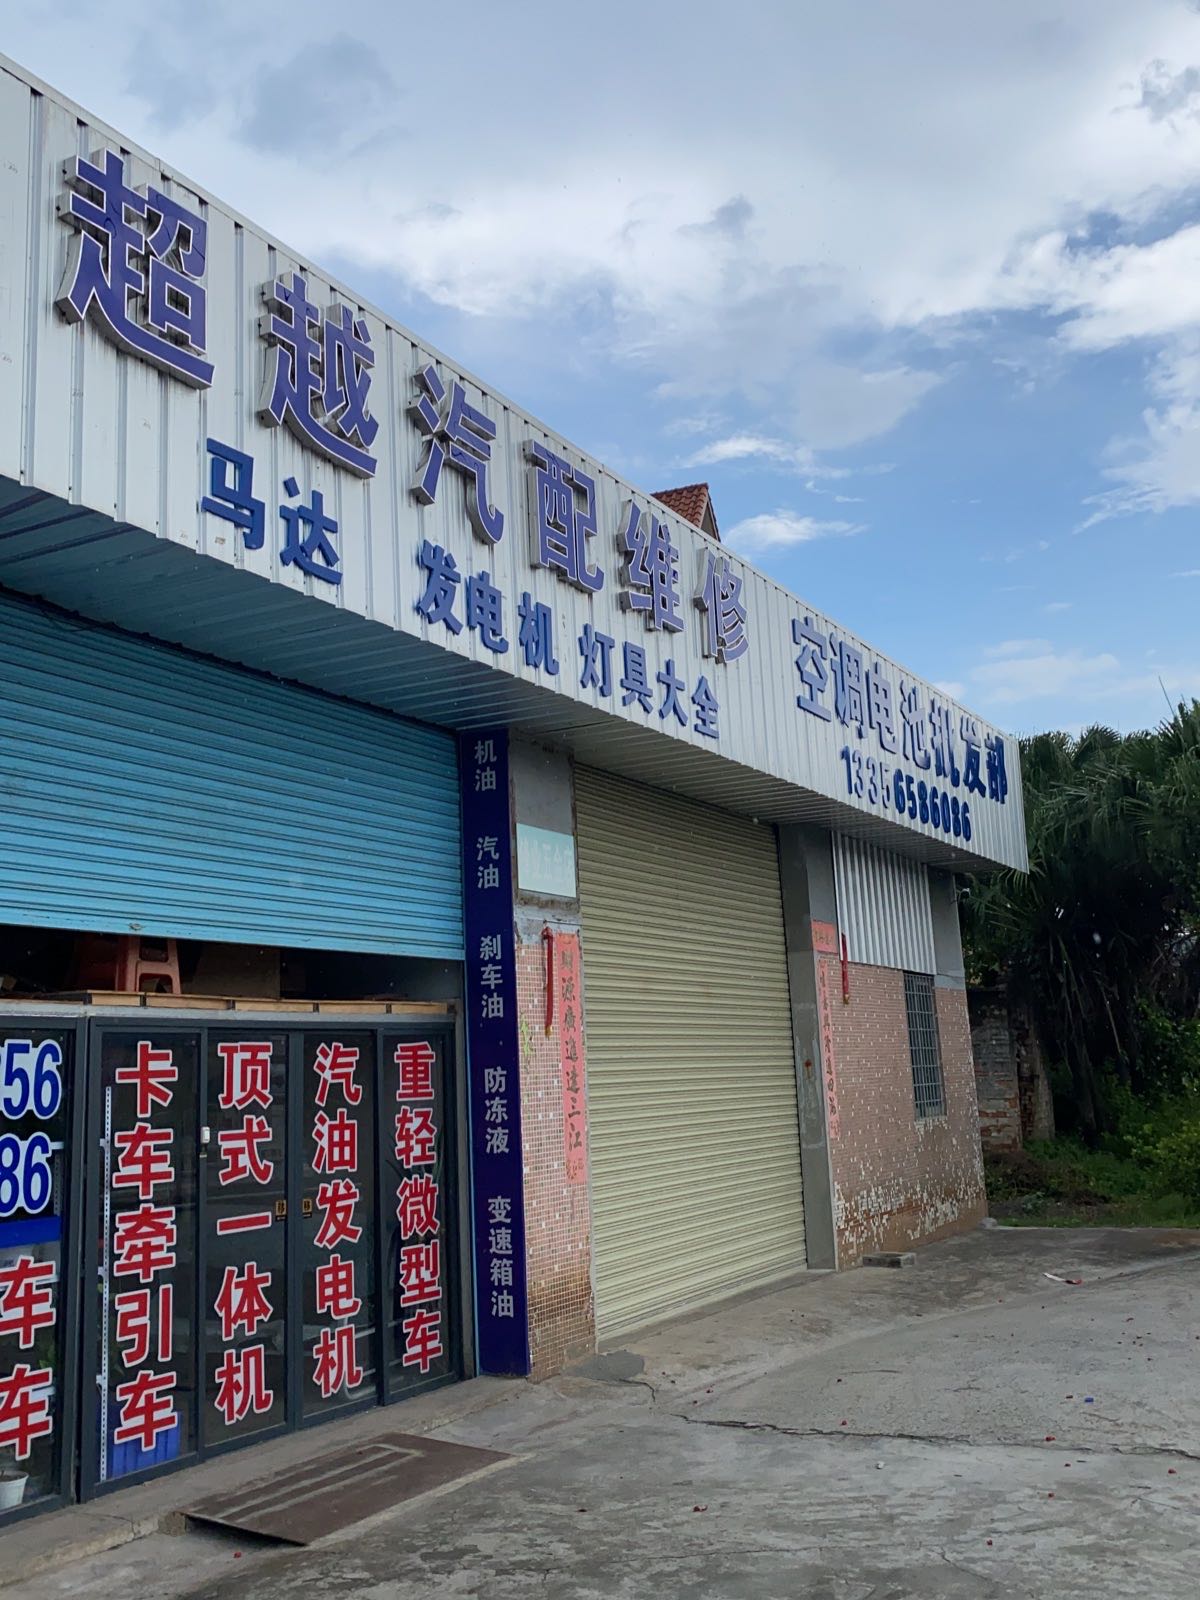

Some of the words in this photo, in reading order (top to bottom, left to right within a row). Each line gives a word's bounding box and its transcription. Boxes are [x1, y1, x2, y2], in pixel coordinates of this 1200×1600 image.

[60, 149, 750, 664] 超越汽配维修
[203, 438, 342, 586] 马达
[416, 539, 560, 676] 发电机
[579, 623, 720, 739] 灯具大全
[474, 740, 497, 792] 机油
[792, 616, 1008, 804] 空调电池批发部
[840, 745, 972, 842] 13356586086
[476, 835, 500, 889] 汽油
[480, 934, 504, 1019] 刹车油
[0, 1039, 62, 1119] 56
[484, 1066, 510, 1154] 防冻液
[0, 1132, 52, 1217] 86
[215, 1041, 273, 1425] 顶式一体机
[312, 1041, 362, 1398] 汽油发电机
[394, 1040, 443, 1374] 重轻微型车
[113, 1040, 178, 1452] 卡车牵引车
[488, 1195, 514, 1318] 变速箱油
